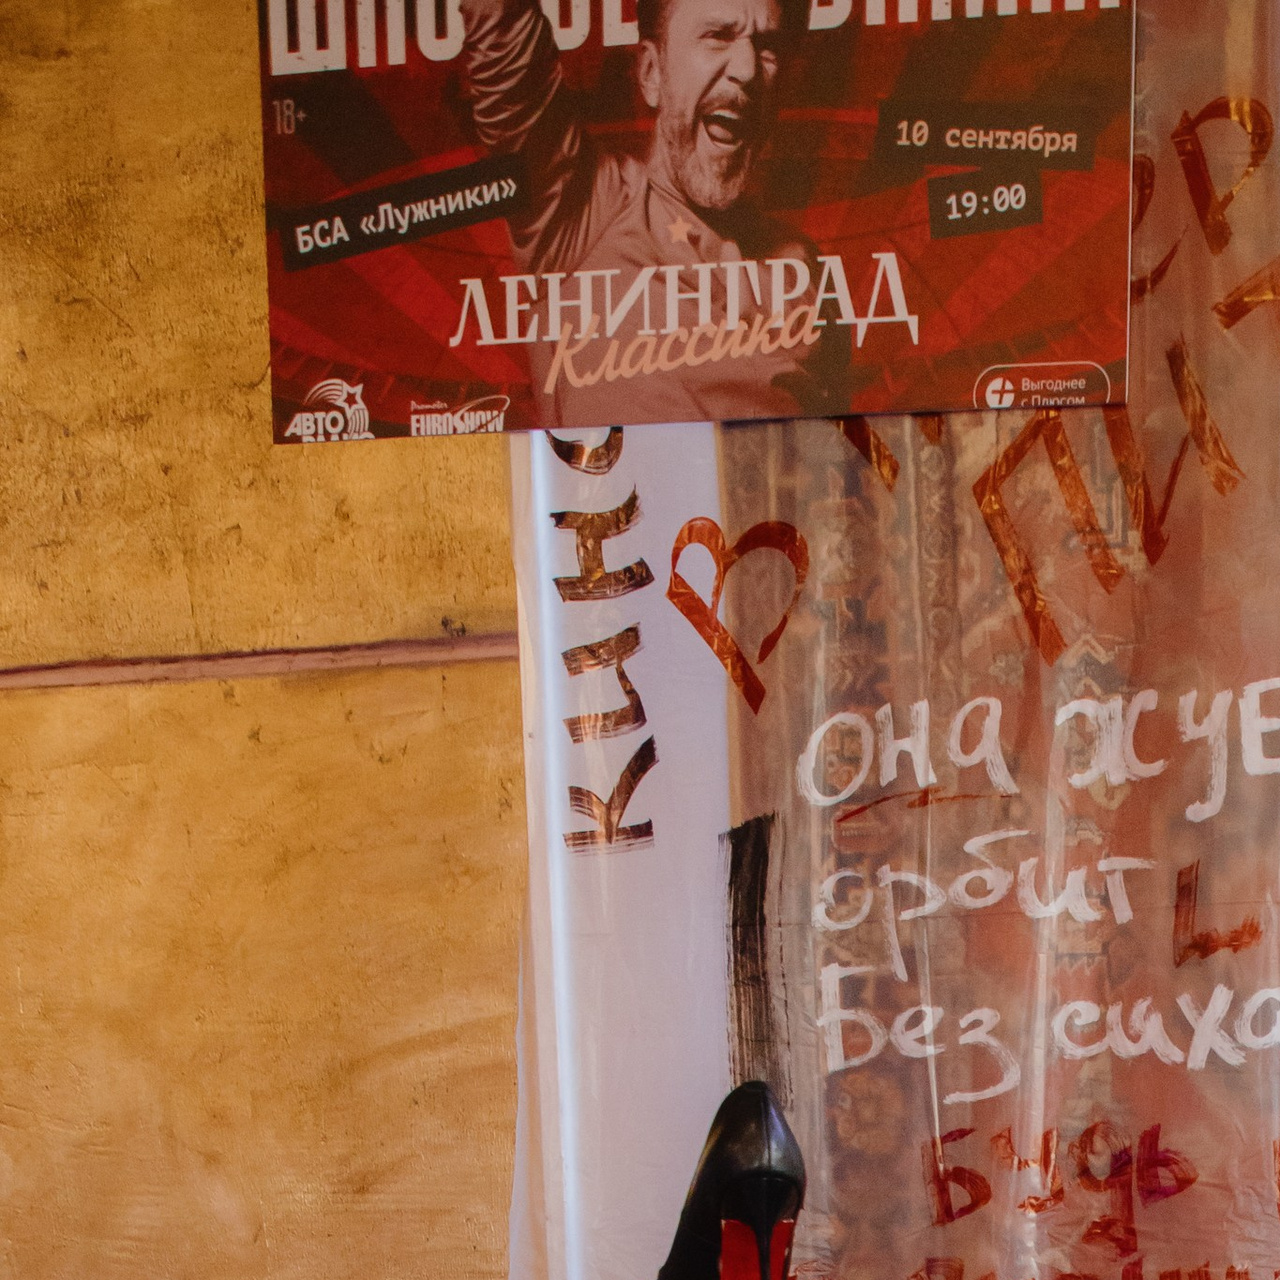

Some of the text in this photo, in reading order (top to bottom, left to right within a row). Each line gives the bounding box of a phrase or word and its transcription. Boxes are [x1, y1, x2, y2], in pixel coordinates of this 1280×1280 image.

[272, 99, 307, 134] 18+
[897, 120, 1078, 158] 10 сентября
[295, 178, 518, 253] БСА «Лужники»
[946, 184, 1027, 220] 19:00
[449, 251, 919, 349] ЛЕНИНГРАД
[544, 304, 824, 395] Классика
[1021, 377, 1086, 392] Выгоднее
[284, 410, 345, 438] АВТО
